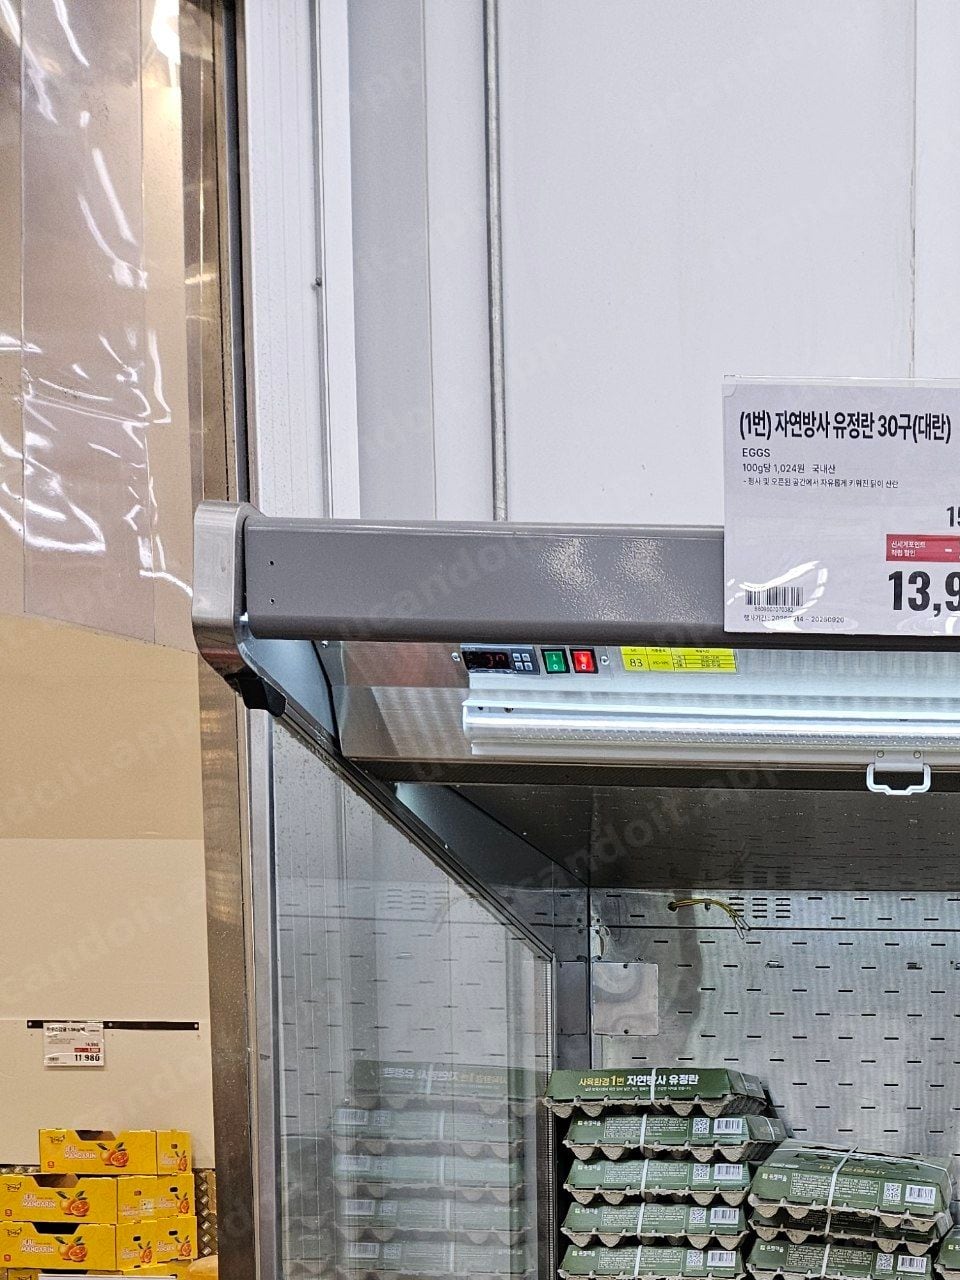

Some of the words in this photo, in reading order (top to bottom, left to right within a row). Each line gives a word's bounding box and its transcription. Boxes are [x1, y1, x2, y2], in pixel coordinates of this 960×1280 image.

[740, 410, 772, 440] (1번)
[775, 410, 830, 438] 자연방사
[833, 412, 875, 439] 유정란
[878, 412, 951, 444] 30구(대란)
[742, 448, 770, 458] EGGS
[742, 464, 770, 474] 100g당
[774, 464, 804, 474] 1,024원
[812, 464, 836, 474] 국내산
[820, 479, 848, 488] 자유롭게
[630, 658, 643, 668] 83
[668, 1074, 698, 1085] 유정란
